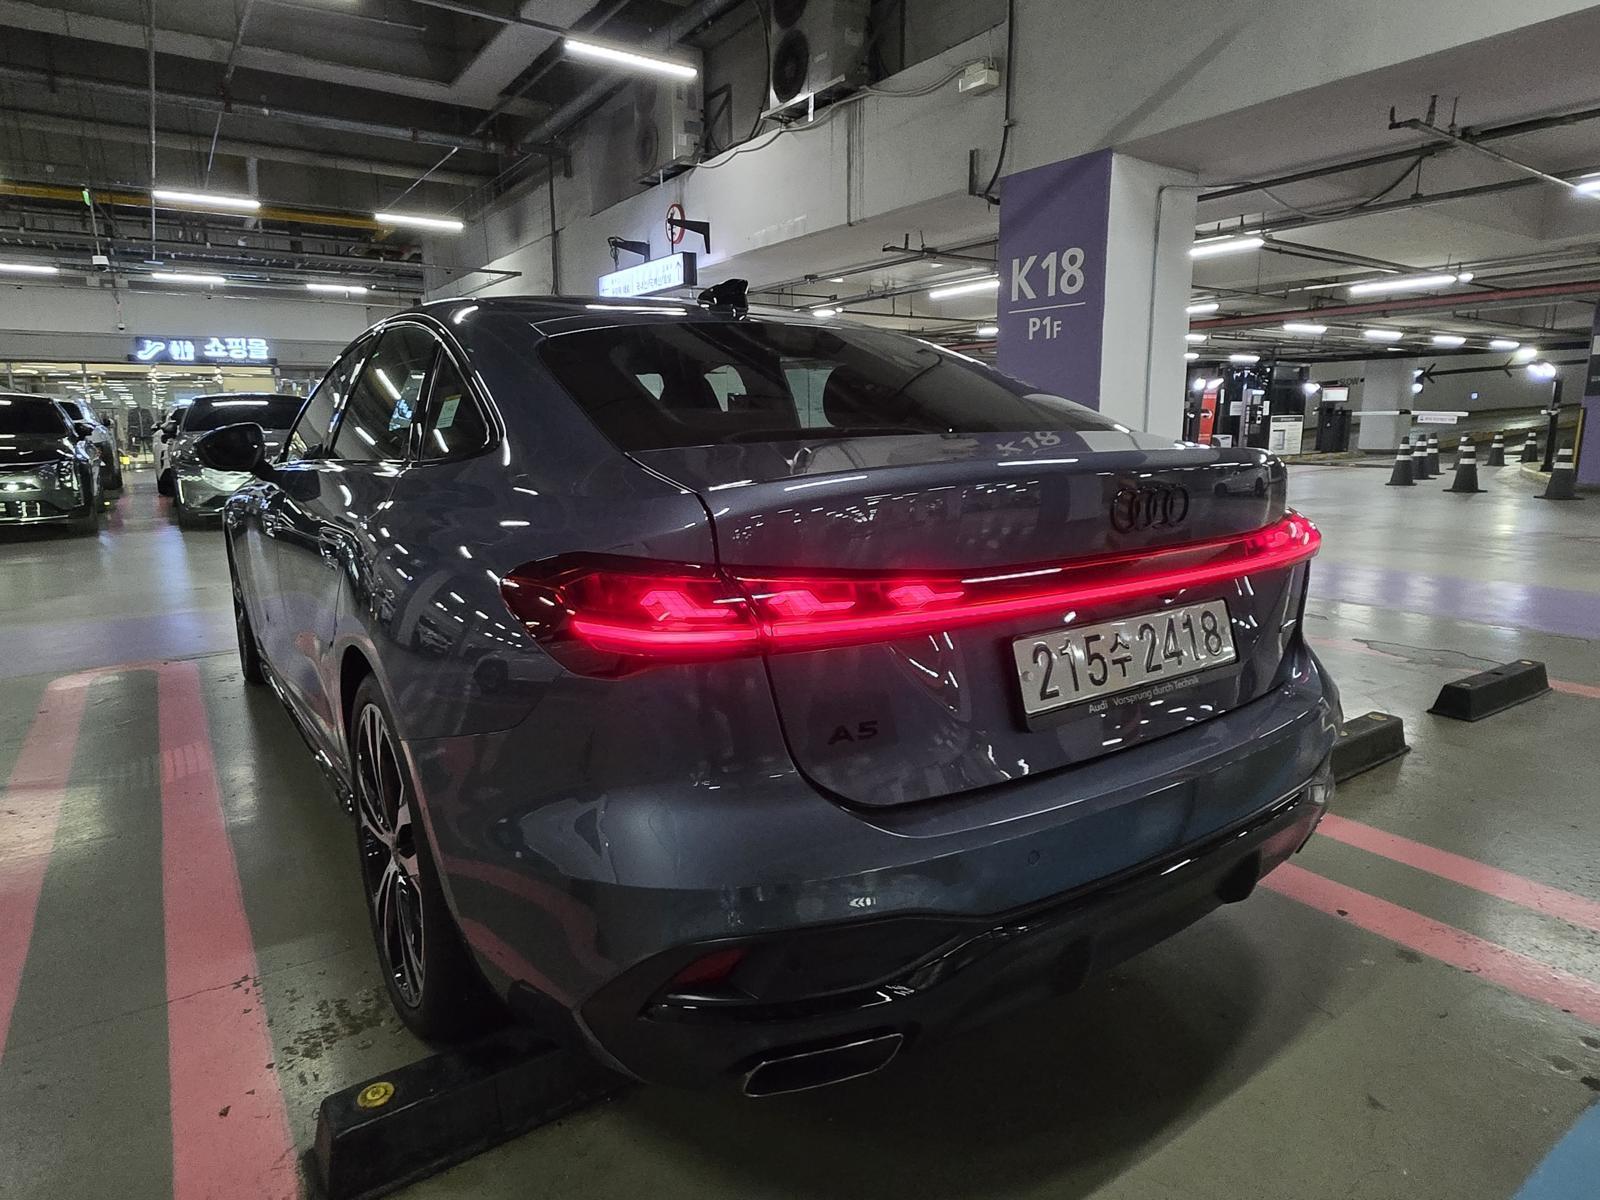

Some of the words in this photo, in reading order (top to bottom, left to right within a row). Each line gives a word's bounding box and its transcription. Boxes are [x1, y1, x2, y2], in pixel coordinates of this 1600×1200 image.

[1011, 247, 1085, 302] K18
[1028, 316, 1063, 340] P1F
[204, 337, 268, 360] 쇼핑몰
[1088, 700, 1109, 713] Audi
[1112, 689, 1153, 706] Vorsprung
[1152, 683, 1174, 696] durch
[827, 720, 879, 745] A5
